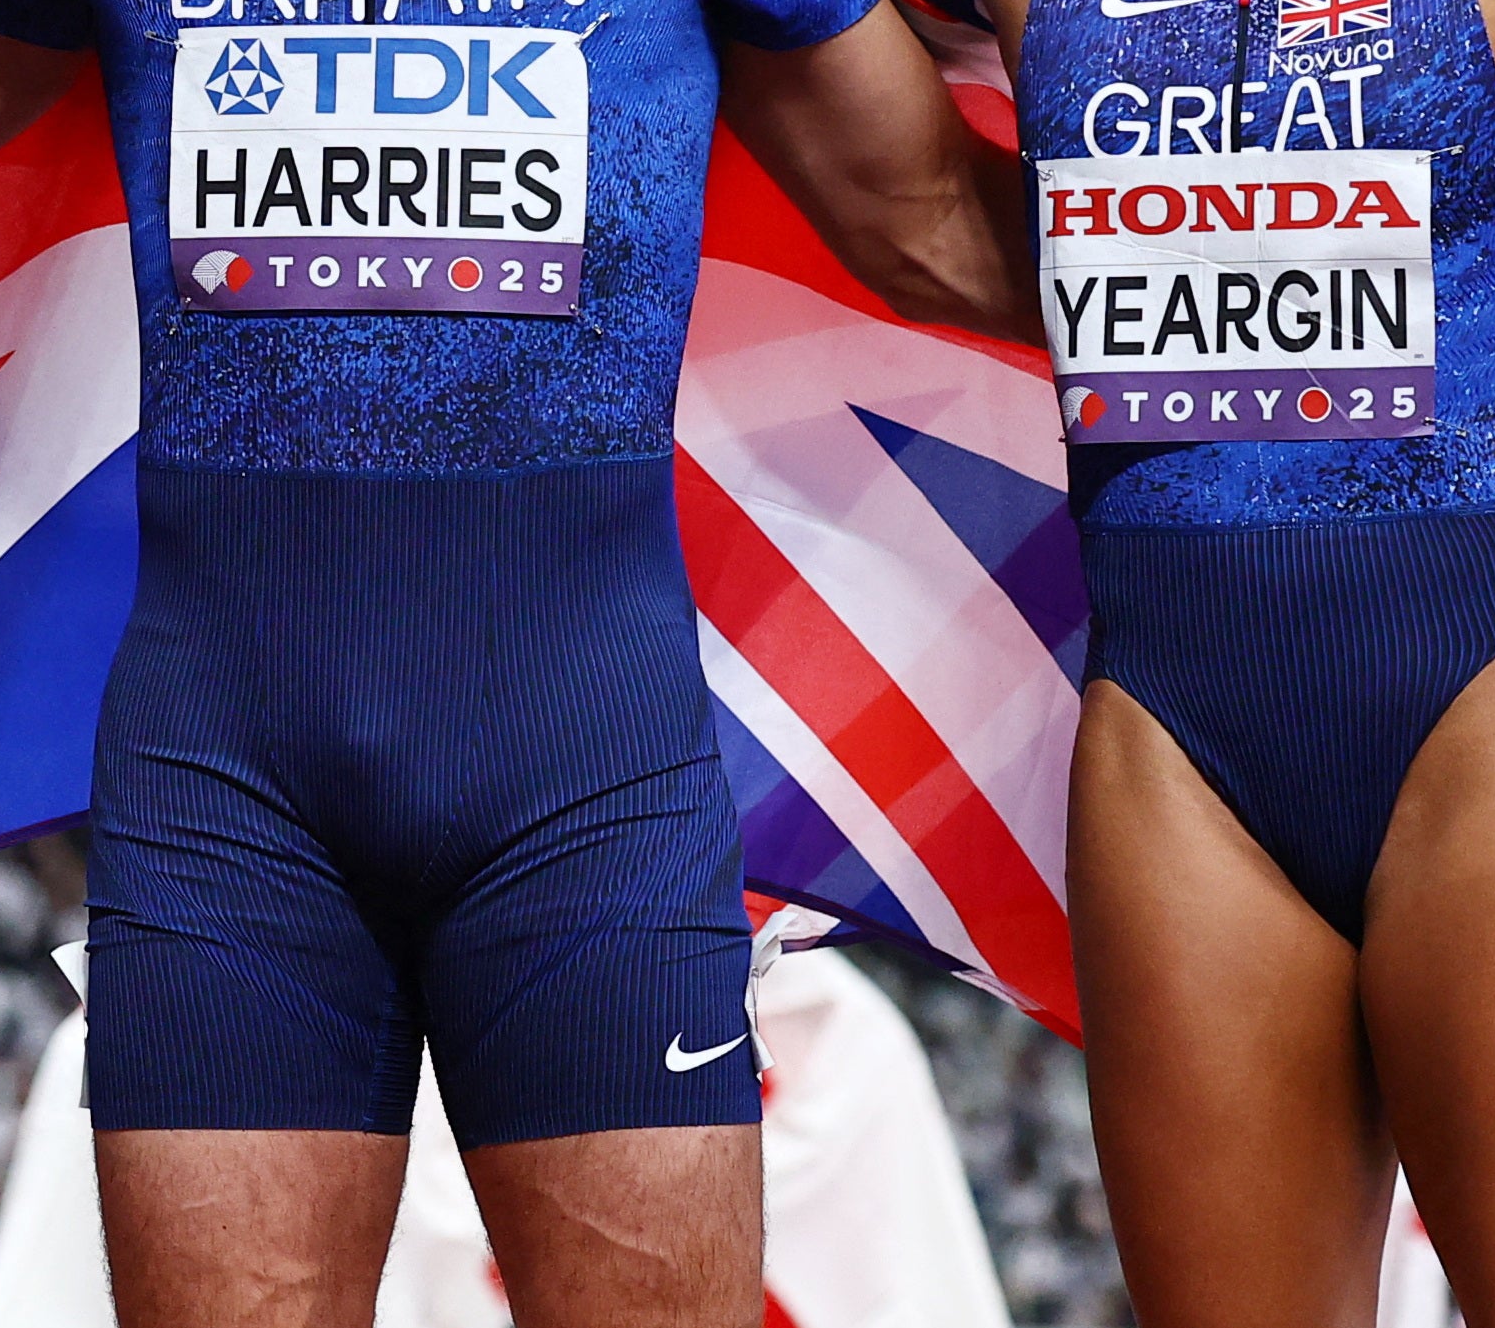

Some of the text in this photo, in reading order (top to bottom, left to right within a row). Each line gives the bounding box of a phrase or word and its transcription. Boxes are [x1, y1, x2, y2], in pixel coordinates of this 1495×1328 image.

[283, 37, 557, 119] TDK
[1269, 39, 1394, 78] Novuna
[1083, 64, 1383, 159] GREAT
[196, 146, 562, 231] HARRIES
[1046, 180, 1420, 237] HONDA
[1054, 268, 1408, 358] YEARGIN
